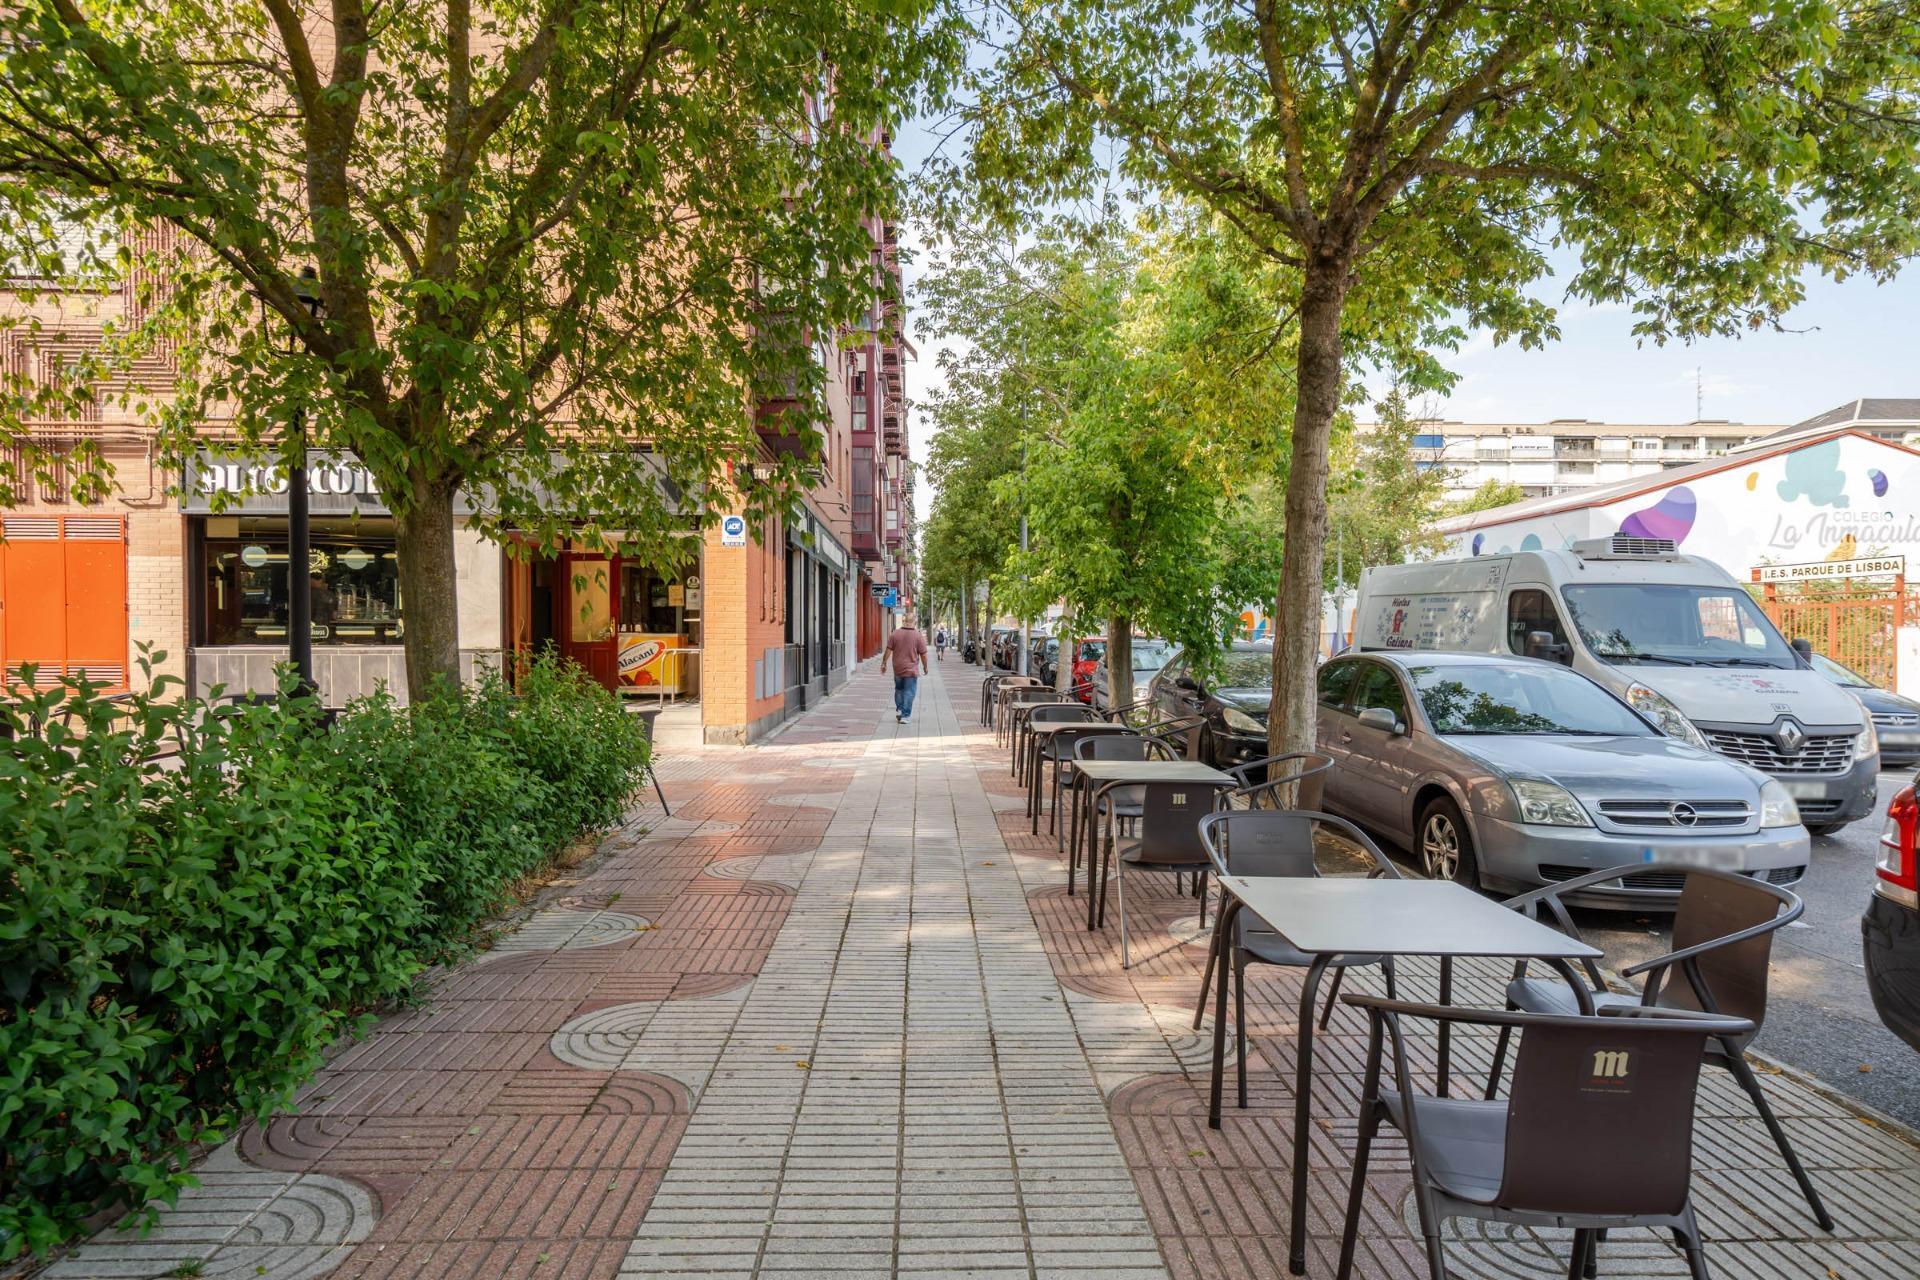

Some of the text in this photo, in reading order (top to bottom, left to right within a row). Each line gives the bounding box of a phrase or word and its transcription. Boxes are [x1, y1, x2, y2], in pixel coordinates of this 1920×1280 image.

[1833, 511, 1893, 522] COLEGIO
[1768, 512, 1801, 549] La
[1764, 569, 1789, 579] I.E.S.
[1791, 566, 1834, 577] PARQUE
[1837, 564, 1852, 574] DE
[1855, 561, 1900, 572] LISBOA
